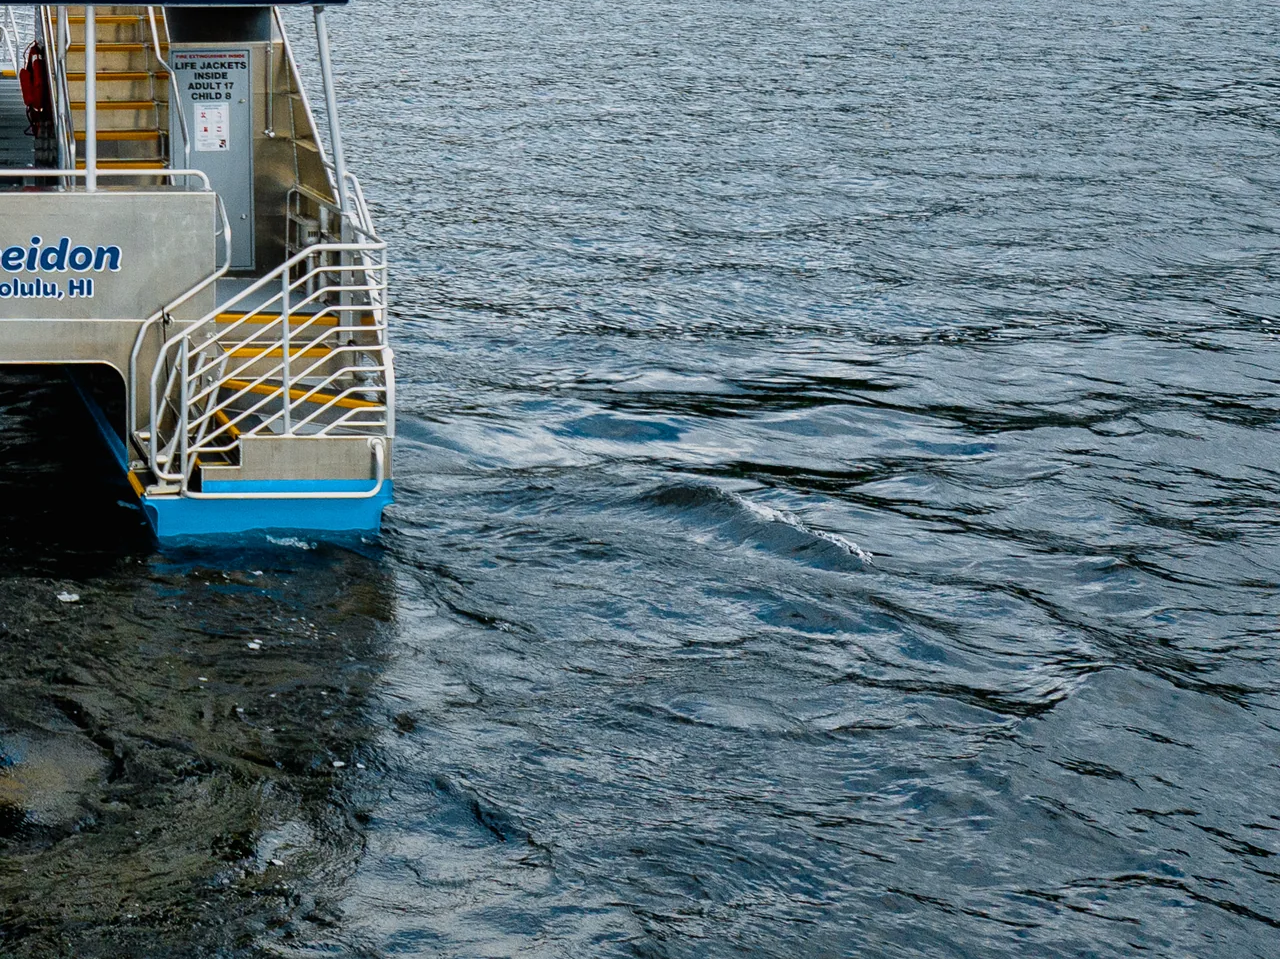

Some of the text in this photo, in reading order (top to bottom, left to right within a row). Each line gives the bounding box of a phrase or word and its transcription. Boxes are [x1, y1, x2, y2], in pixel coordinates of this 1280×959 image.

[175, 62, 247, 70] LIFE JACKETS
[194, 72, 228, 80] INSIDE
[188, 82, 234, 90] ADULT 17
[191, 92, 232, 100] CHILD 8
[68, 279, 94, 298] HI
